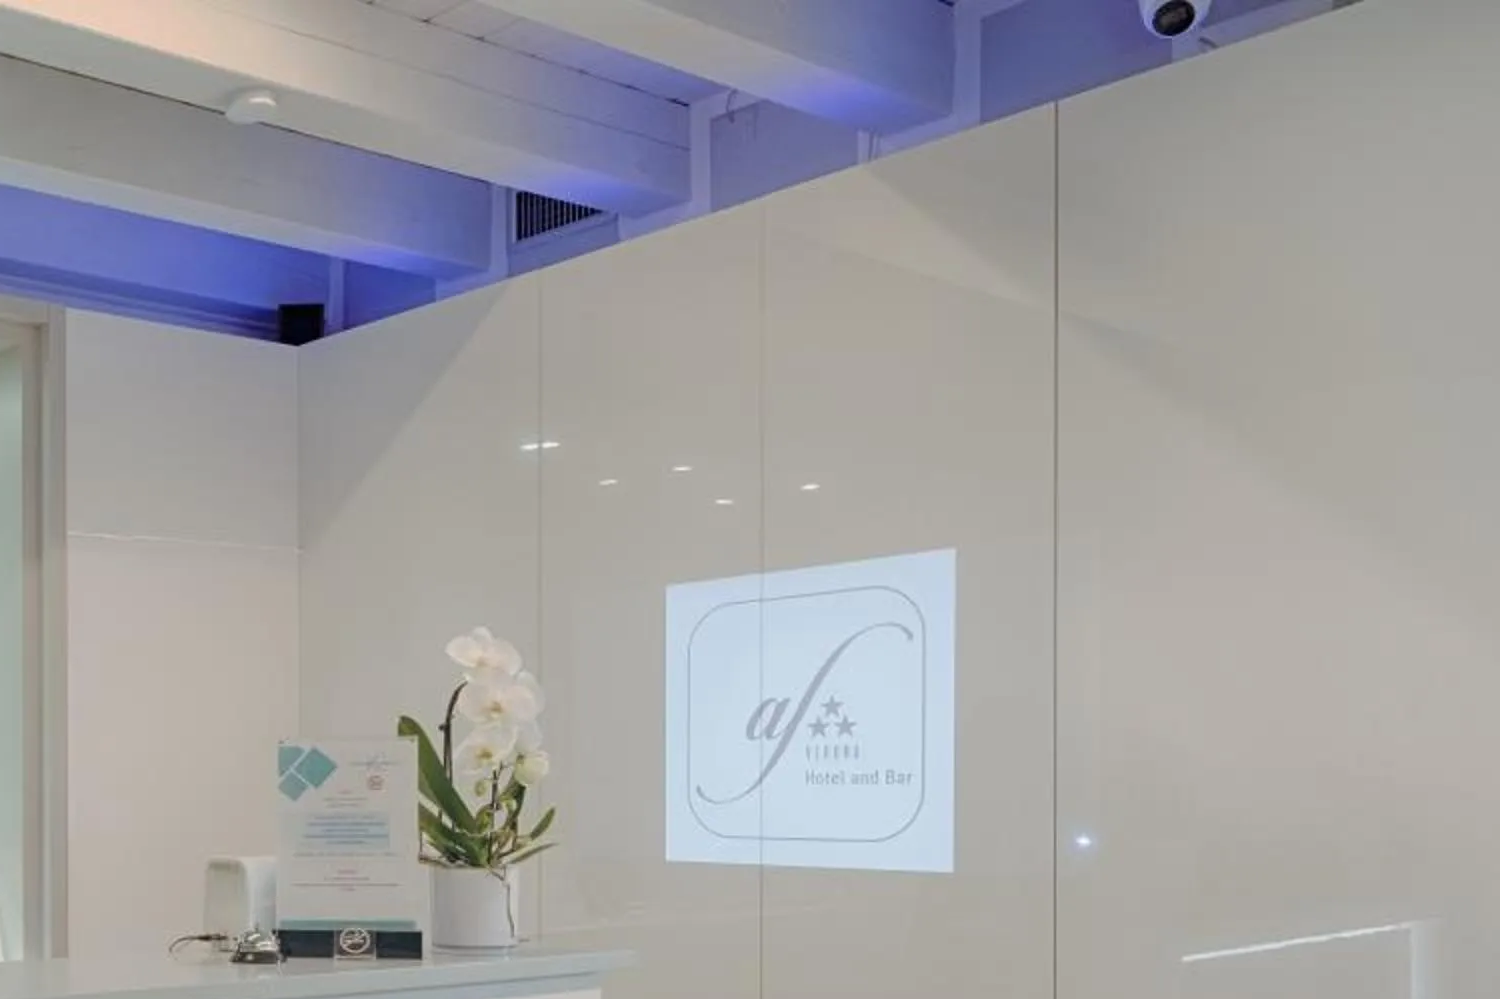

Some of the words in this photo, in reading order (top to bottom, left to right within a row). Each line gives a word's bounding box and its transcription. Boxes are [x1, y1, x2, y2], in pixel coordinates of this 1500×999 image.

[804, 769, 846, 786] Hotel
[851, 769, 880, 785] and
[884, 768, 914, 785] Bar
